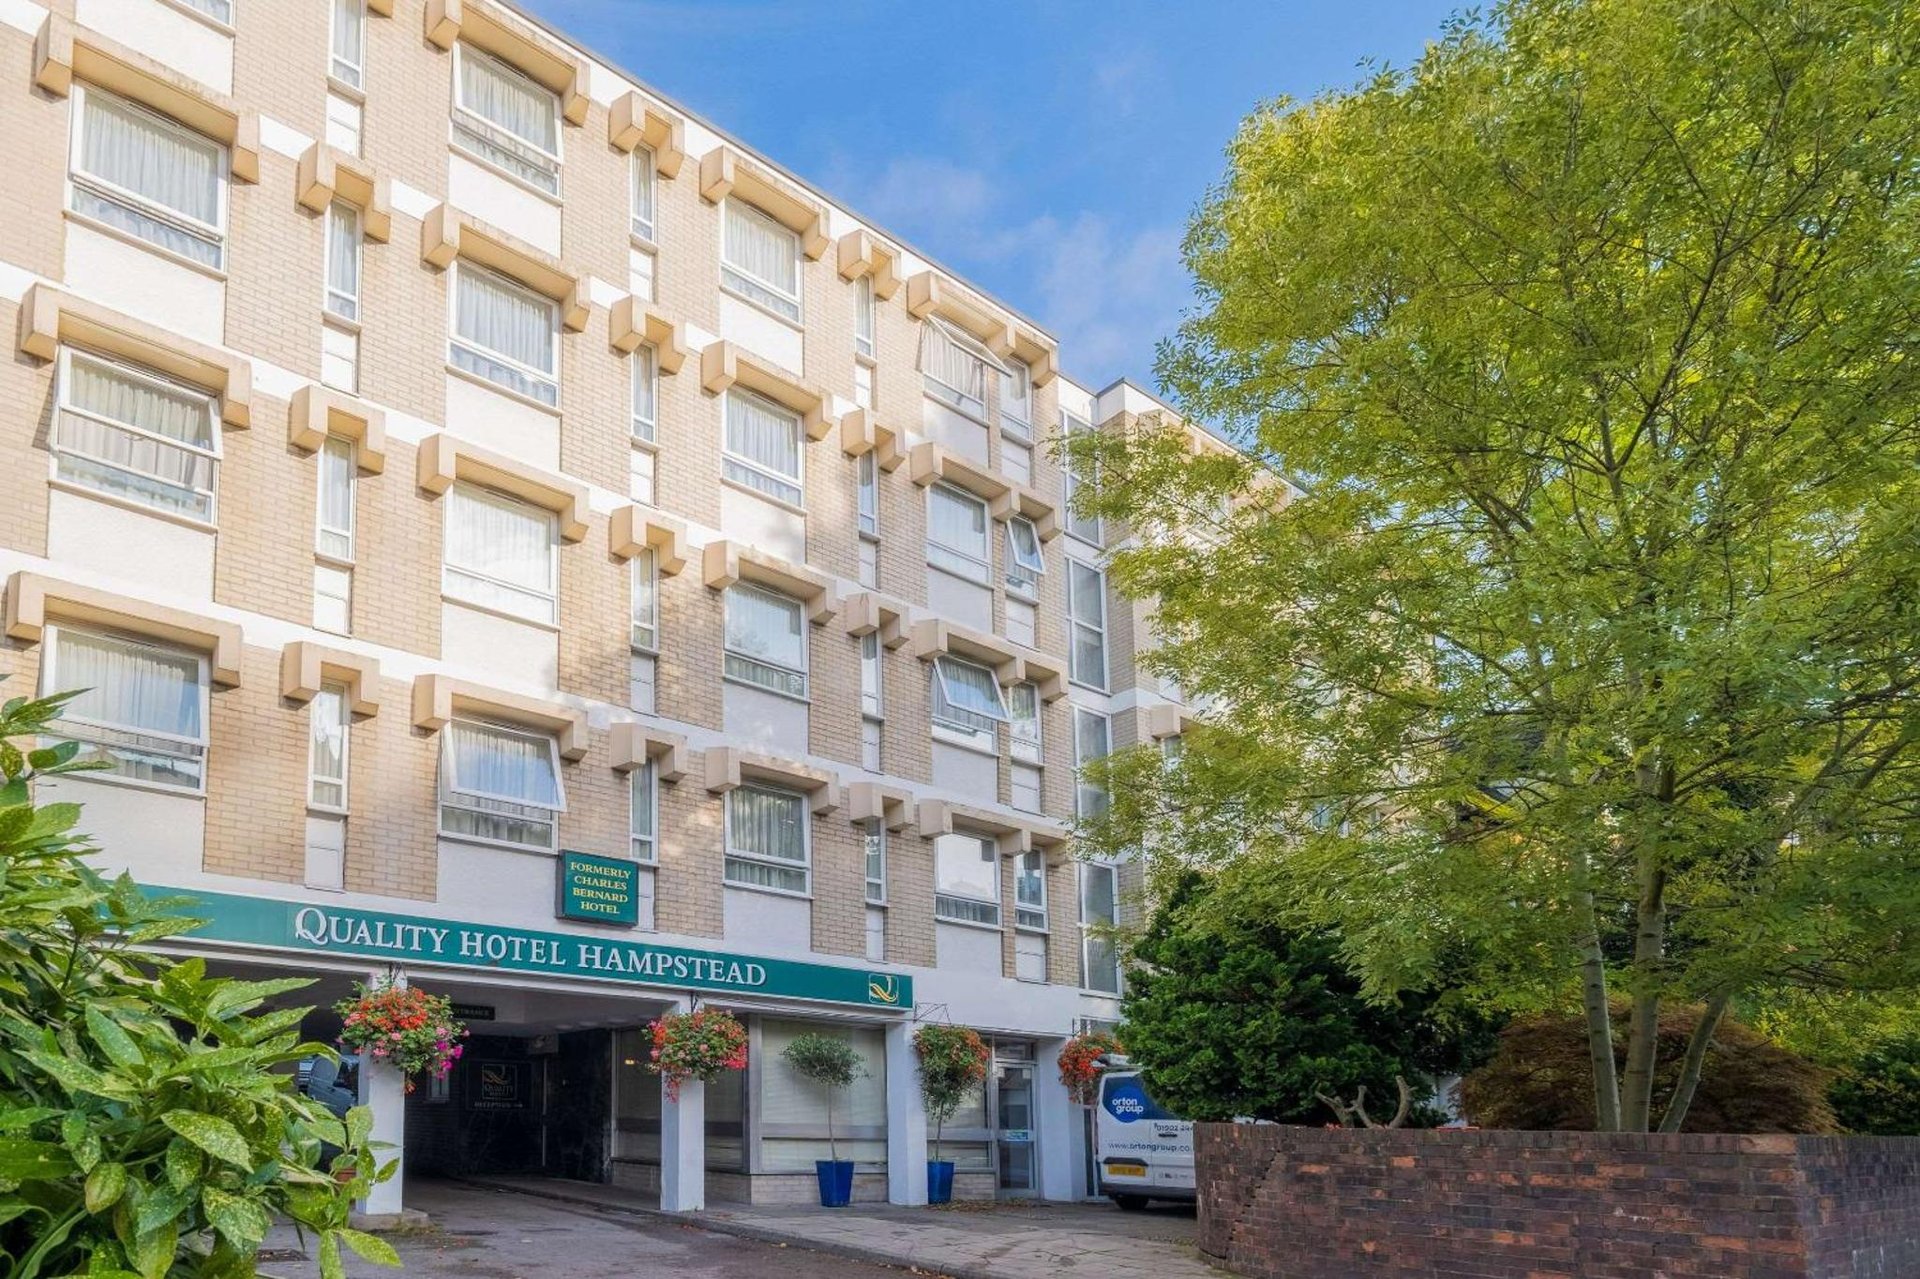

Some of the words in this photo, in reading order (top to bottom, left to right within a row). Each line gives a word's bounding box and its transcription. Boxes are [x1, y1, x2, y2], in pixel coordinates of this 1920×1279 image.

[570, 861, 631, 879] FORMERLY
[574, 875, 628, 891] CHARLES
[572, 887, 628, 903] BERNARD
[580, 901, 620, 914] HOTEL
[295, 907, 449, 953] QUALITY
[459, 930, 566, 966] HOTEL
[577, 944, 767, 986] HAMPSTEAD
[1112, 1097, 1138, 1106] orton
[1116, 1104, 1144, 1115] group
